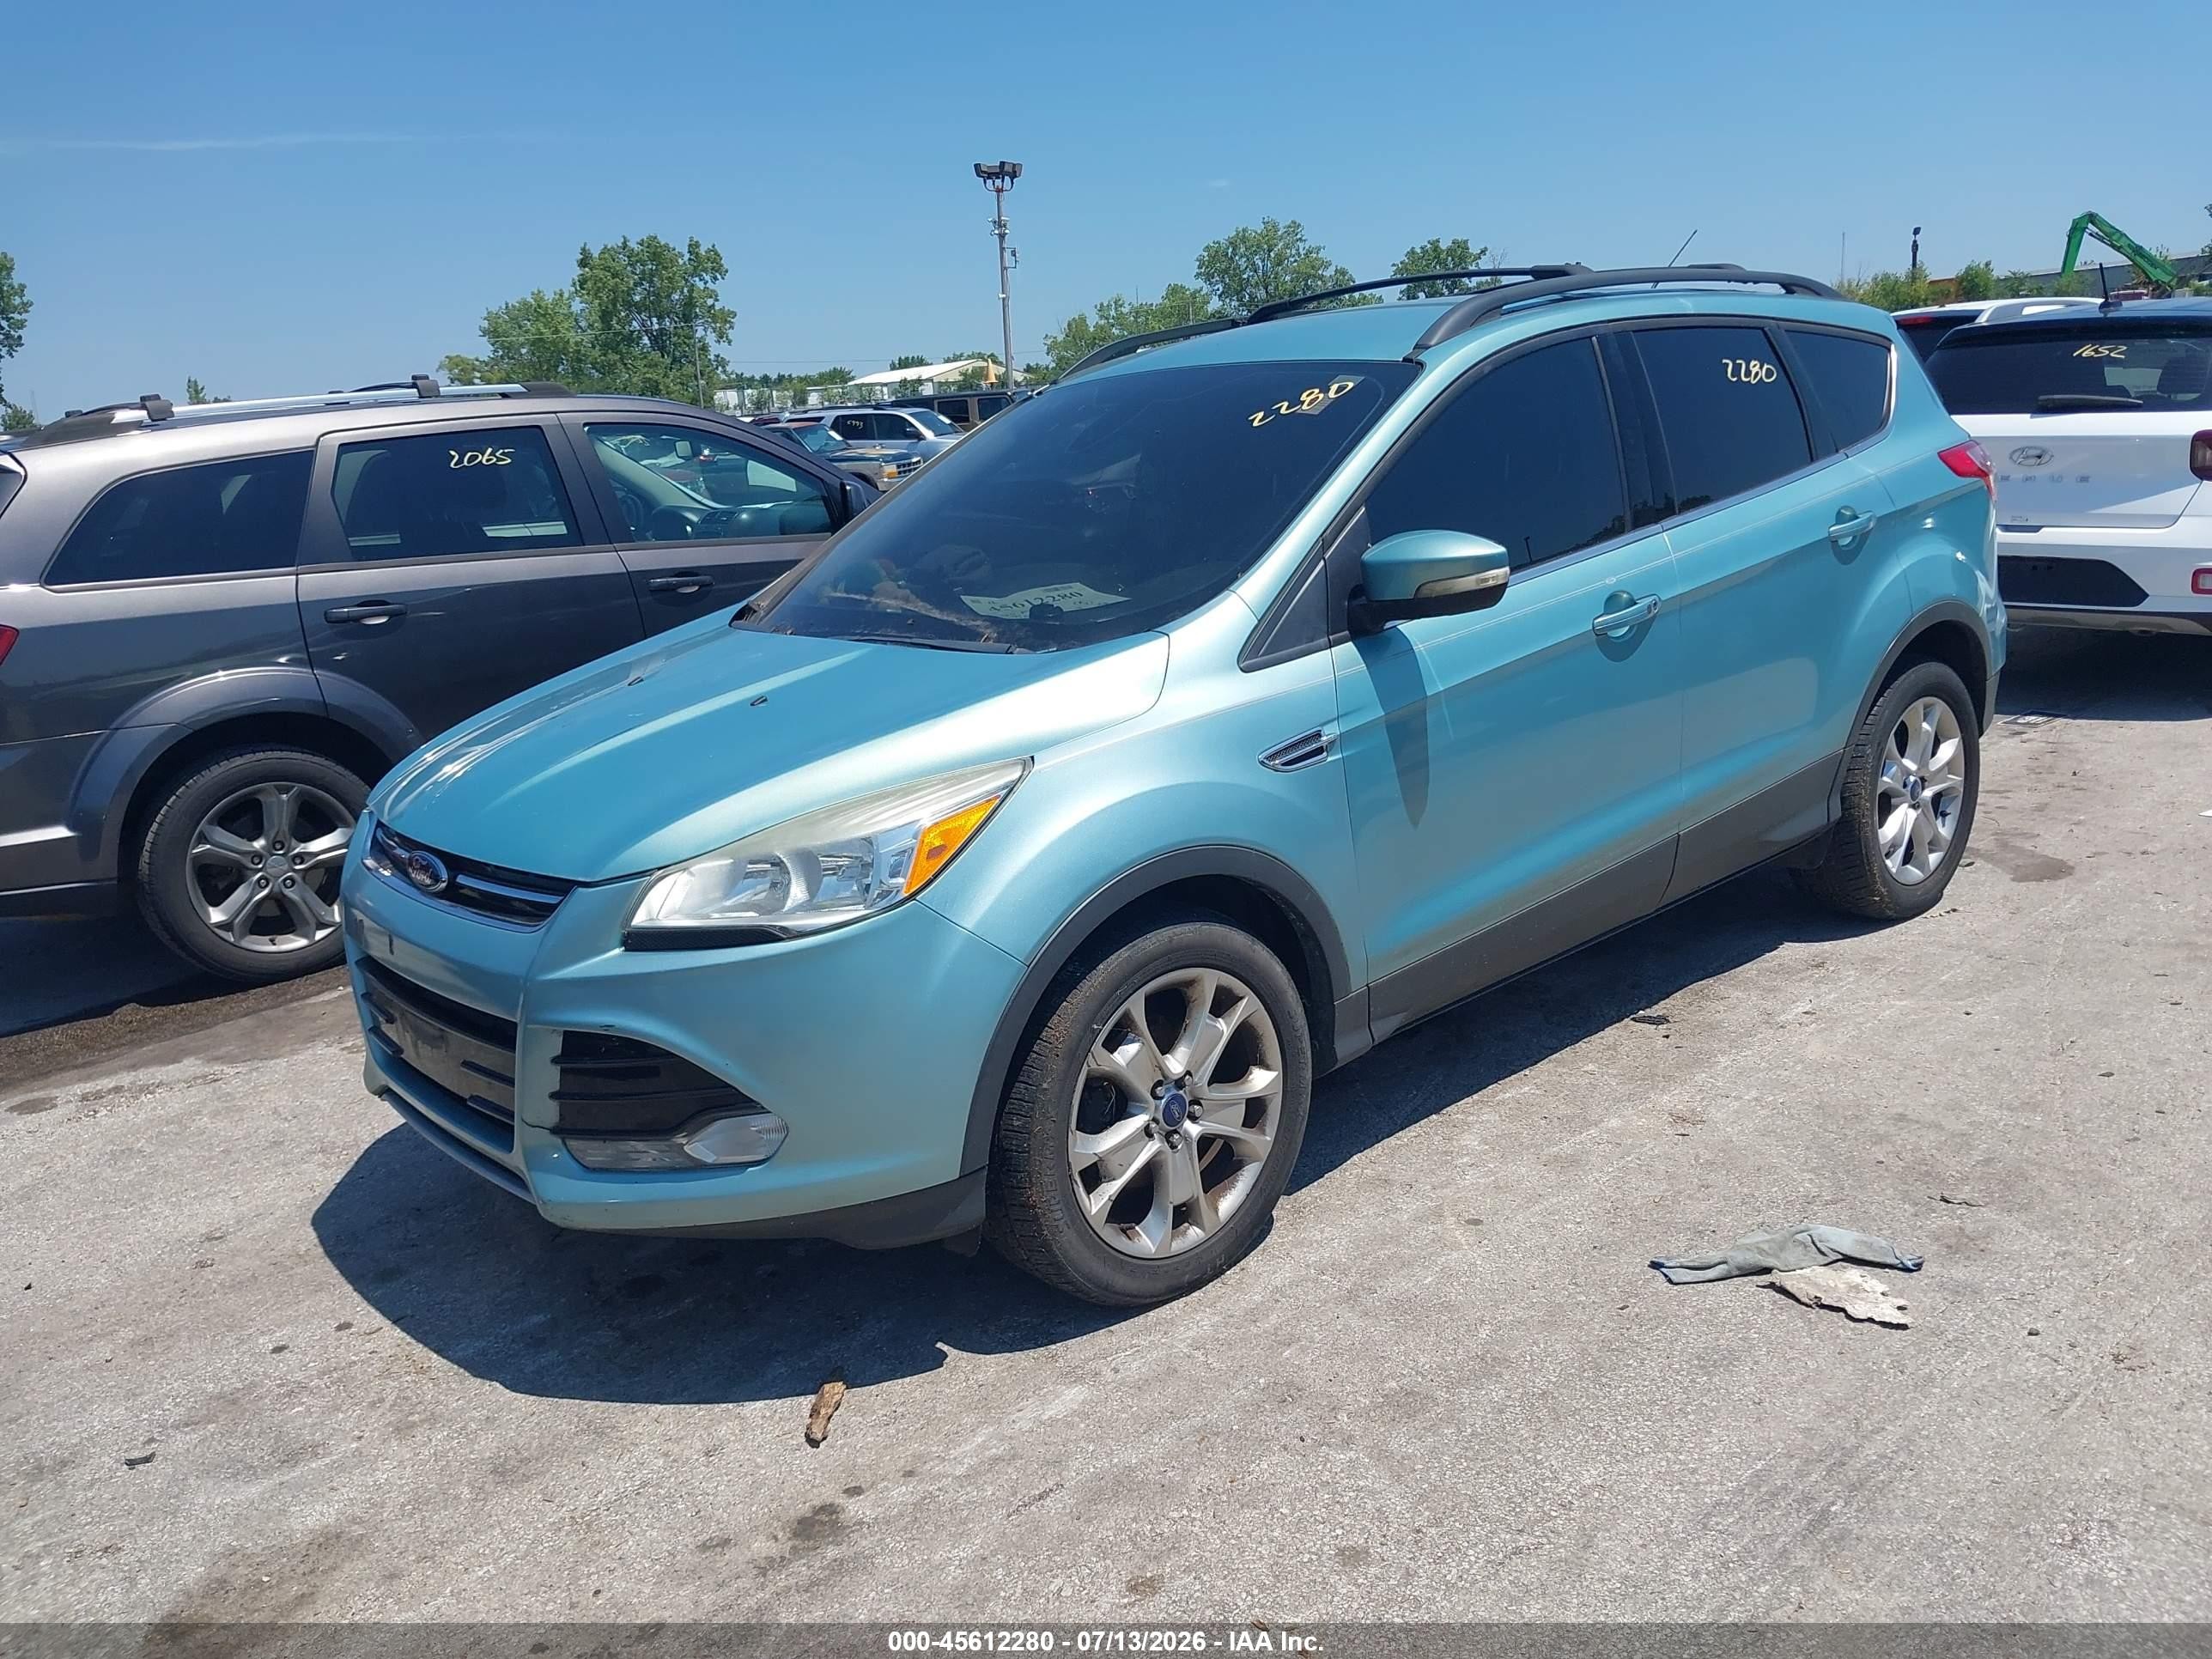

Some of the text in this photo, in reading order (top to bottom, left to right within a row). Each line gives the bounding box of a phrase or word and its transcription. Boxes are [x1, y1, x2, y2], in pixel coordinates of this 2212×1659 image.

[2073, 344, 2127, 359] 1652
[1722, 359, 1777, 384] 2280
[1248, 381, 1354, 427] 2280
[448, 447, 515, 468] 2065
